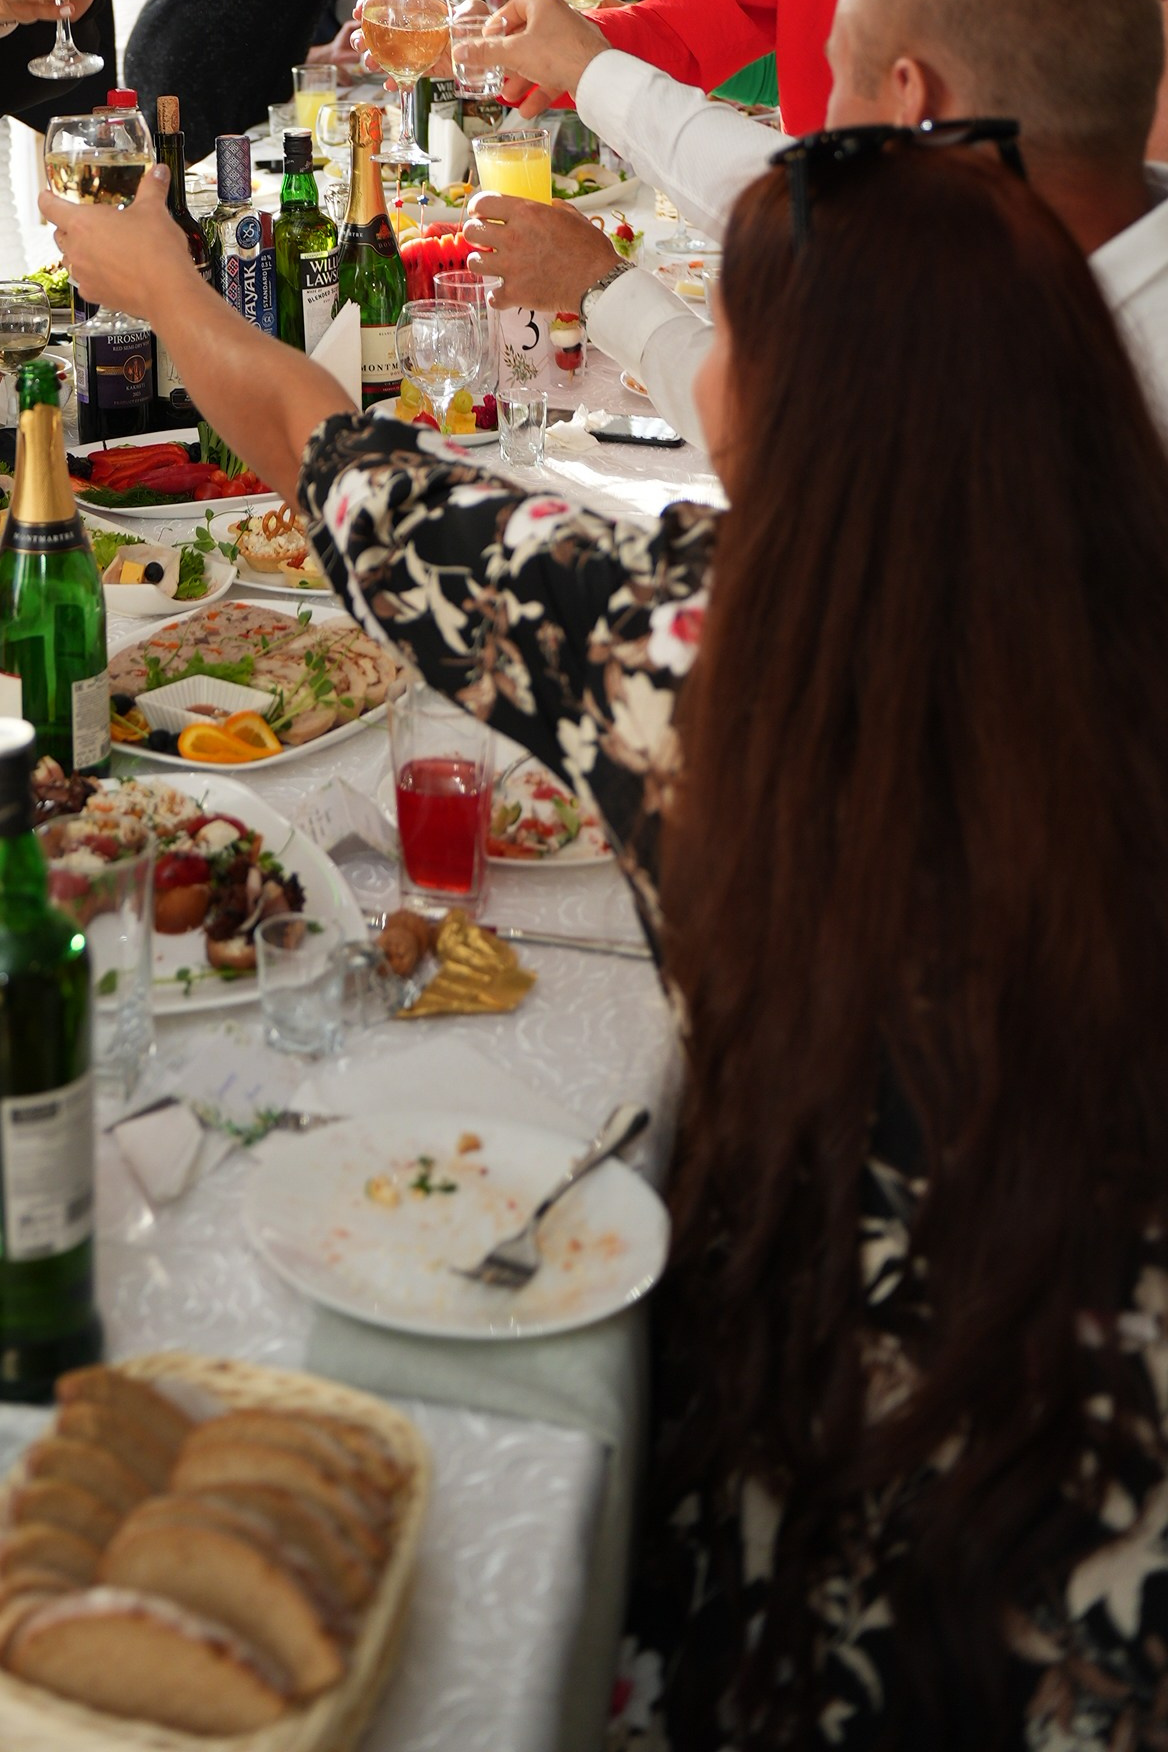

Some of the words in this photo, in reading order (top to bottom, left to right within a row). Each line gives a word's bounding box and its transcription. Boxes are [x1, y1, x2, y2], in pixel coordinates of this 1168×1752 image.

[436, 81, 456, 92] WIL
[433, 91, 457, 102] LAW
[310, 256, 339, 273] WILL
[306, 269, 339, 287] LAWS
[307, 291, 330, 304] BLENDED
[518, 307, 540, 351] 3
[13, 532, 75, 544] MONTMARTRE
